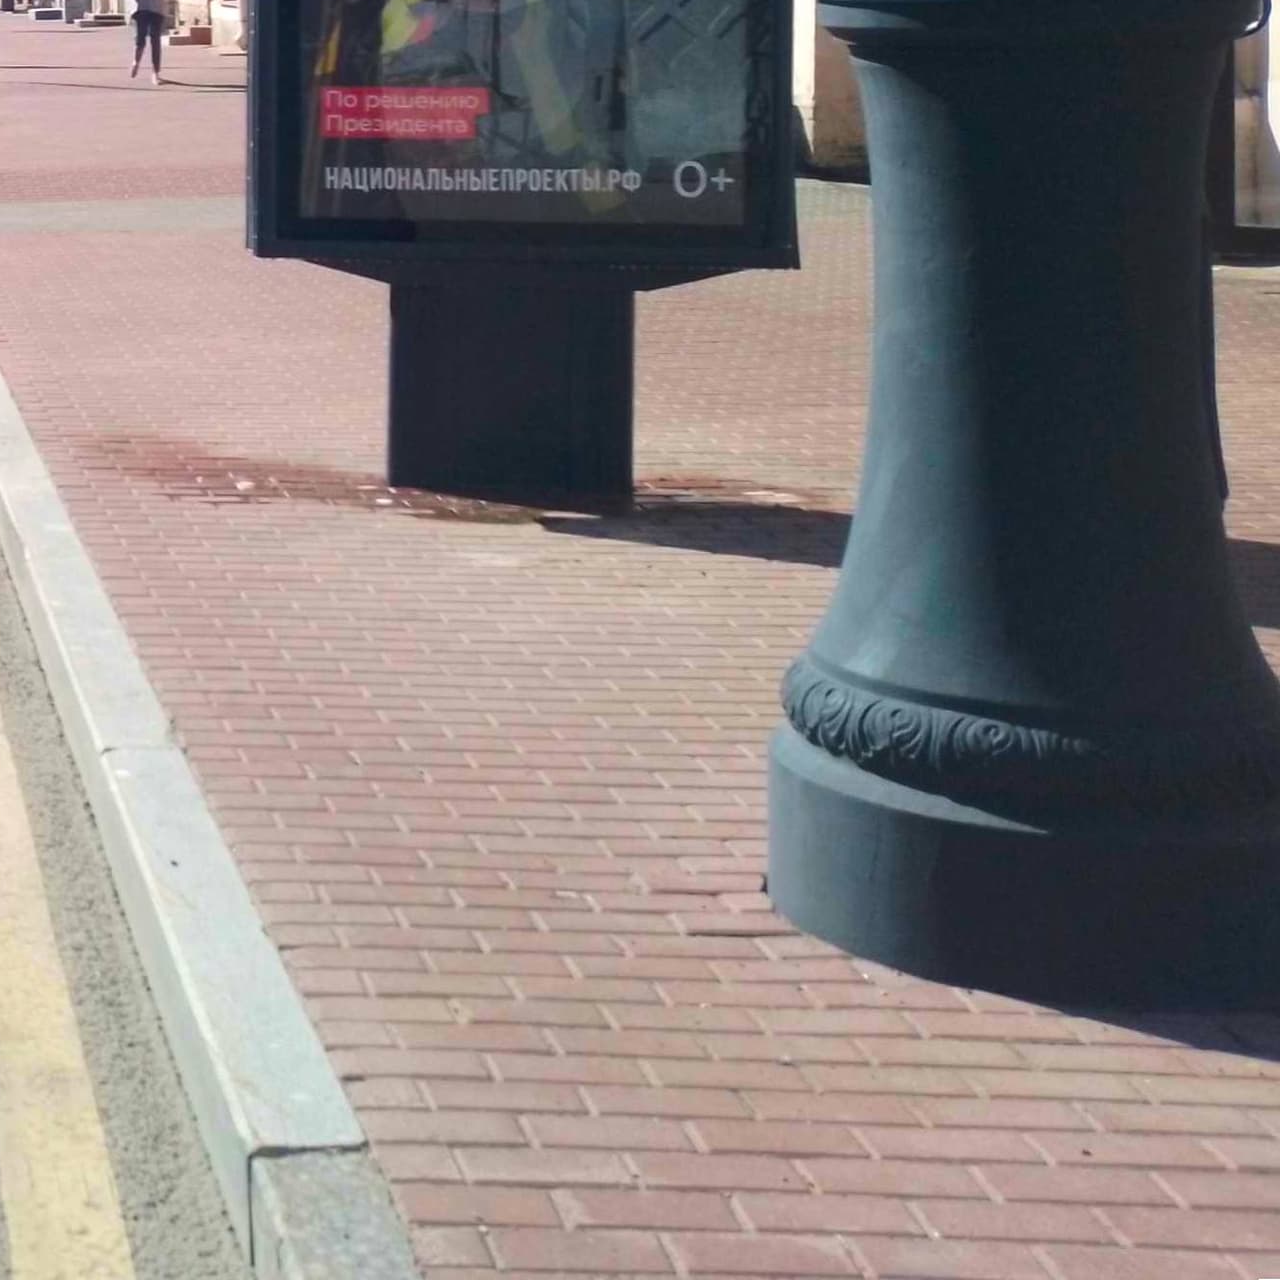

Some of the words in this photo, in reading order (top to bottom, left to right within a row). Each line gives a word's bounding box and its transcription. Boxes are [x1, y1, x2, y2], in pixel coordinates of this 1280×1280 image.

[325, 90, 358, 110] По
[365, 91, 480, 111] решению
[326, 115, 469, 135] Президента
[324, 166, 641, 192] НАЦИОНАЛЬНЫЕПРОЕКТЫ.РФ
